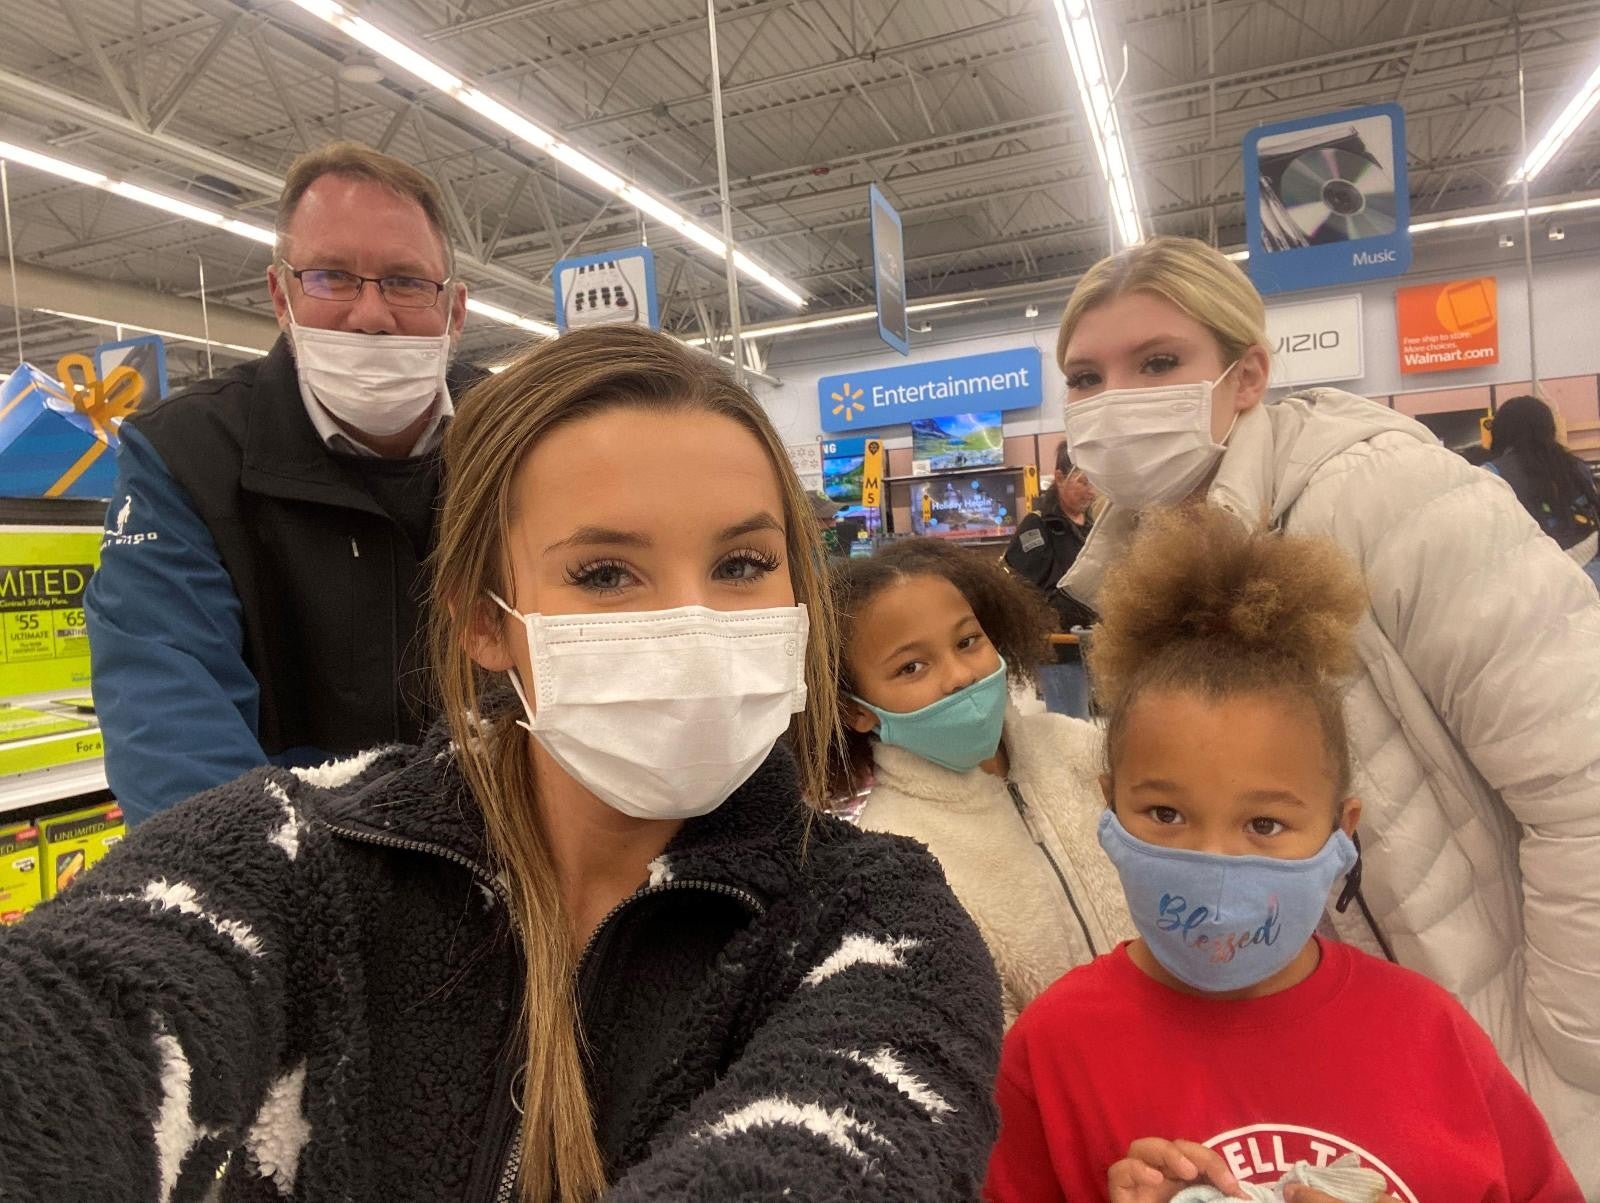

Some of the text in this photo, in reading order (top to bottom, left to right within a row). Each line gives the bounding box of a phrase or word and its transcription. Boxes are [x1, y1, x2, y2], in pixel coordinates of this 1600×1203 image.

[1352, 249, 1397, 266] Music
[1403, 336, 1421, 345] Free
[1440, 333, 1449, 341] to
[1404, 345, 1425, 354] More
[1404, 347, 1495, 367] Walmart.com
[872, 367, 1029, 407] Entertainment
[865, 477, 879, 490] M
[15, 613, 40, 631] $55
[76, 741, 94, 753] For
[54, 822, 106, 841] UNLIMITED
[1157, 892, 1281, 964] Blessed
